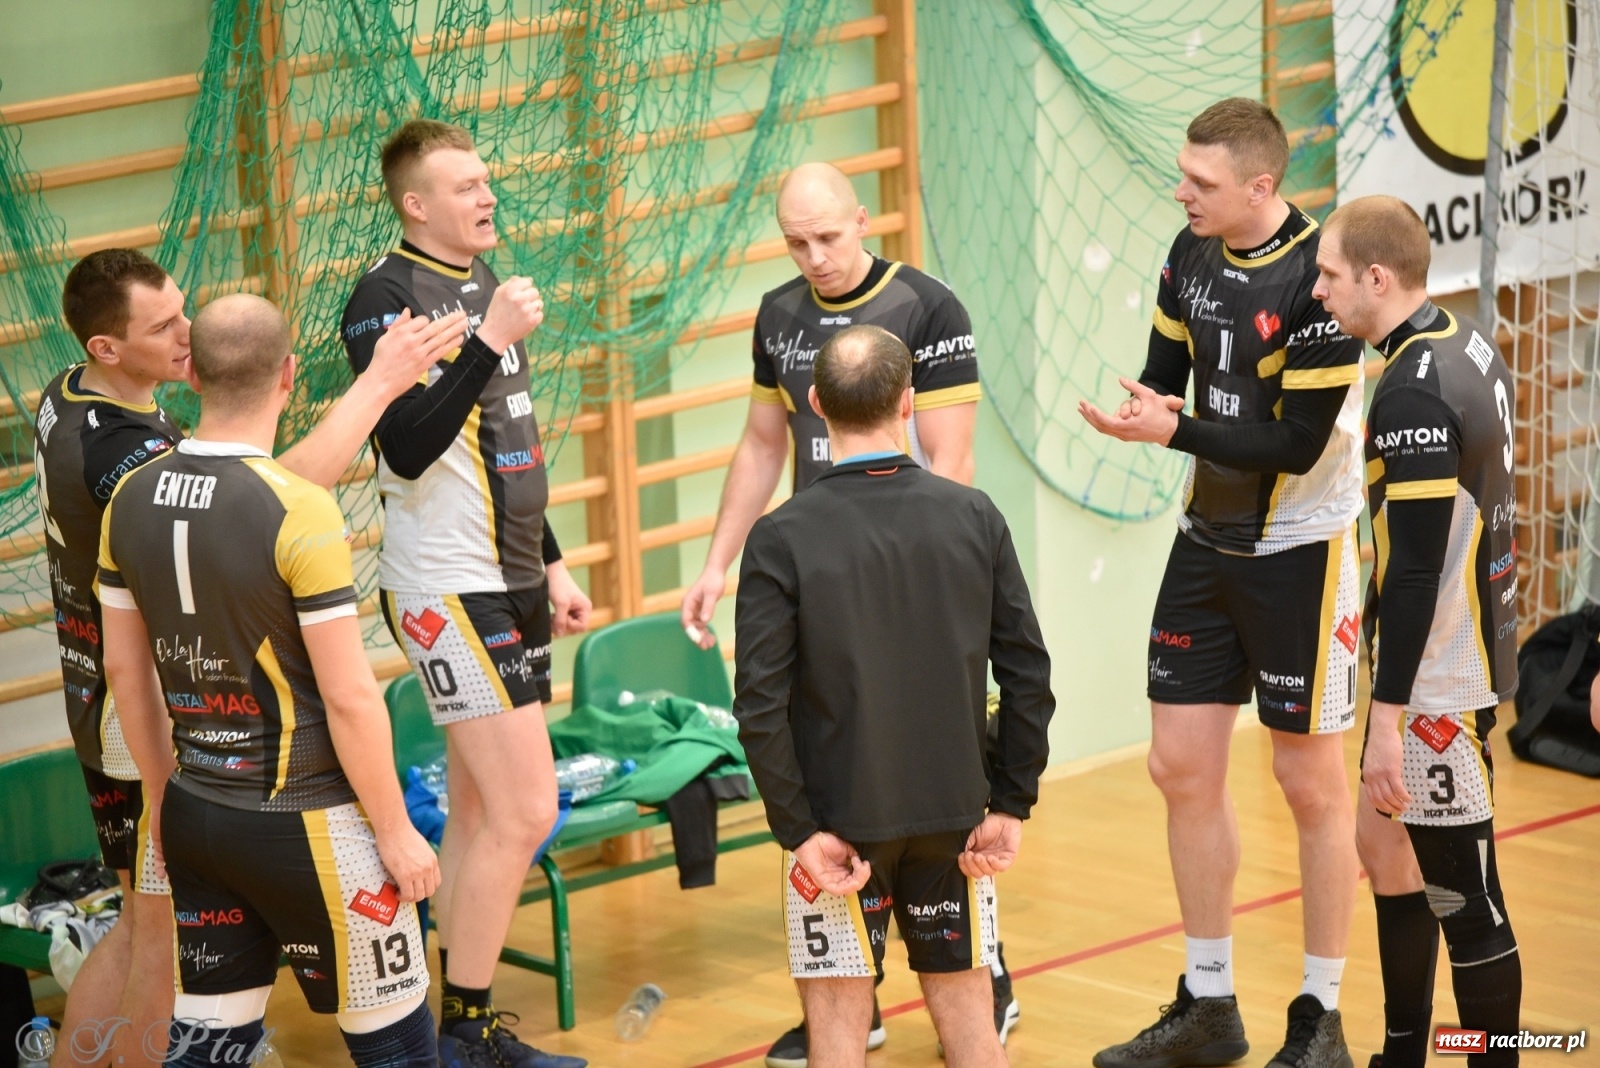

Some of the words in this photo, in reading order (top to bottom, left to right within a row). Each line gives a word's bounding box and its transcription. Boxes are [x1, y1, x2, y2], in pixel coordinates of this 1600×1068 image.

[1249, 239, 1281, 258] KIPSTA
[780, 329, 821, 375] Hair
[1494, 378, 1514, 474] 3
[1401, 447, 1414, 455] druk
[153, 471, 217, 510] ENTER
[405, 615, 432, 640] Enter
[186, 636, 229, 683] Hair
[419, 658, 458, 698] 10
[1260, 670, 1304, 687] GRAVTON
[1419, 717, 1445, 742] Enter
[1427, 764, 1455, 804] 3
[794, 866, 816, 891] Enter
[359, 893, 392, 915] Enter
[907, 900, 960, 916] GRAVTON
[803, 914, 829, 957] 5
[193, 941, 224, 972] Hair
[371, 931, 411, 980] 13
